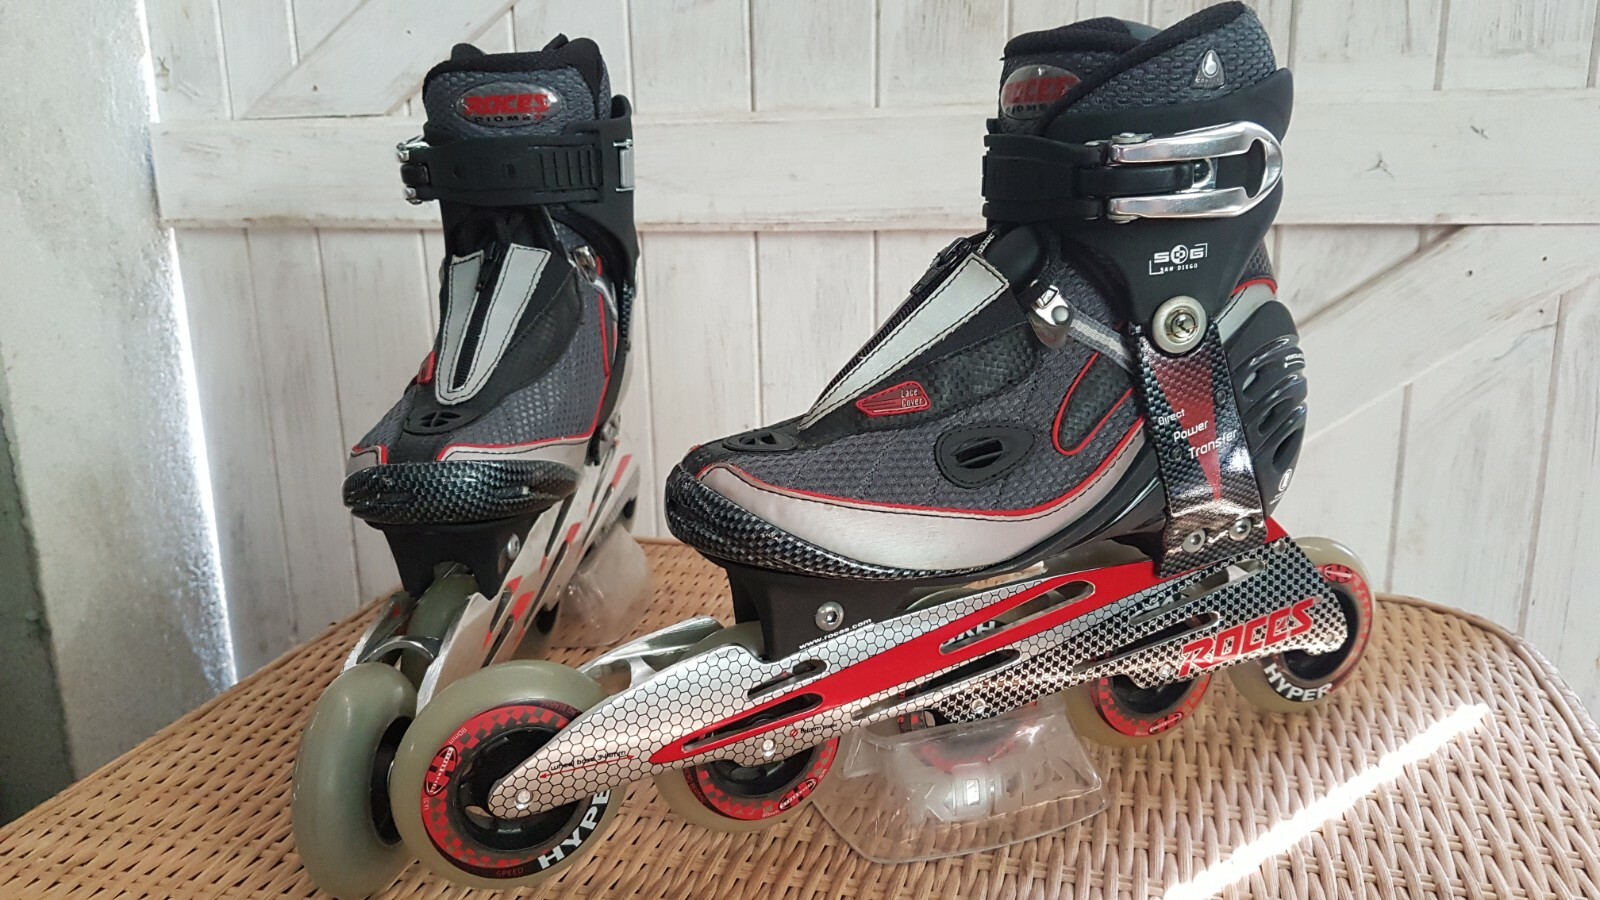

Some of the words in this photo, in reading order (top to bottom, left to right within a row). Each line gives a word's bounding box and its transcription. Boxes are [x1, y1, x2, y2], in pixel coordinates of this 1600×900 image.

[464, 94, 549, 116] ROCES
[1177, 263, 1198, 271] DIEGO
[901, 388, 918, 398] Lace
[901, 398, 923, 408] Cover
[1158, 408, 1185, 426] Direct
[1173, 420, 1209, 442] Power
[1188, 429, 1238, 460] Transfer
[798, 618, 872, 650] www.roces.com
[1178, 597, 1315, 678] ROCES
[1263, 663, 1333, 702] HYPER
[496, 867, 524, 877] SPEED
